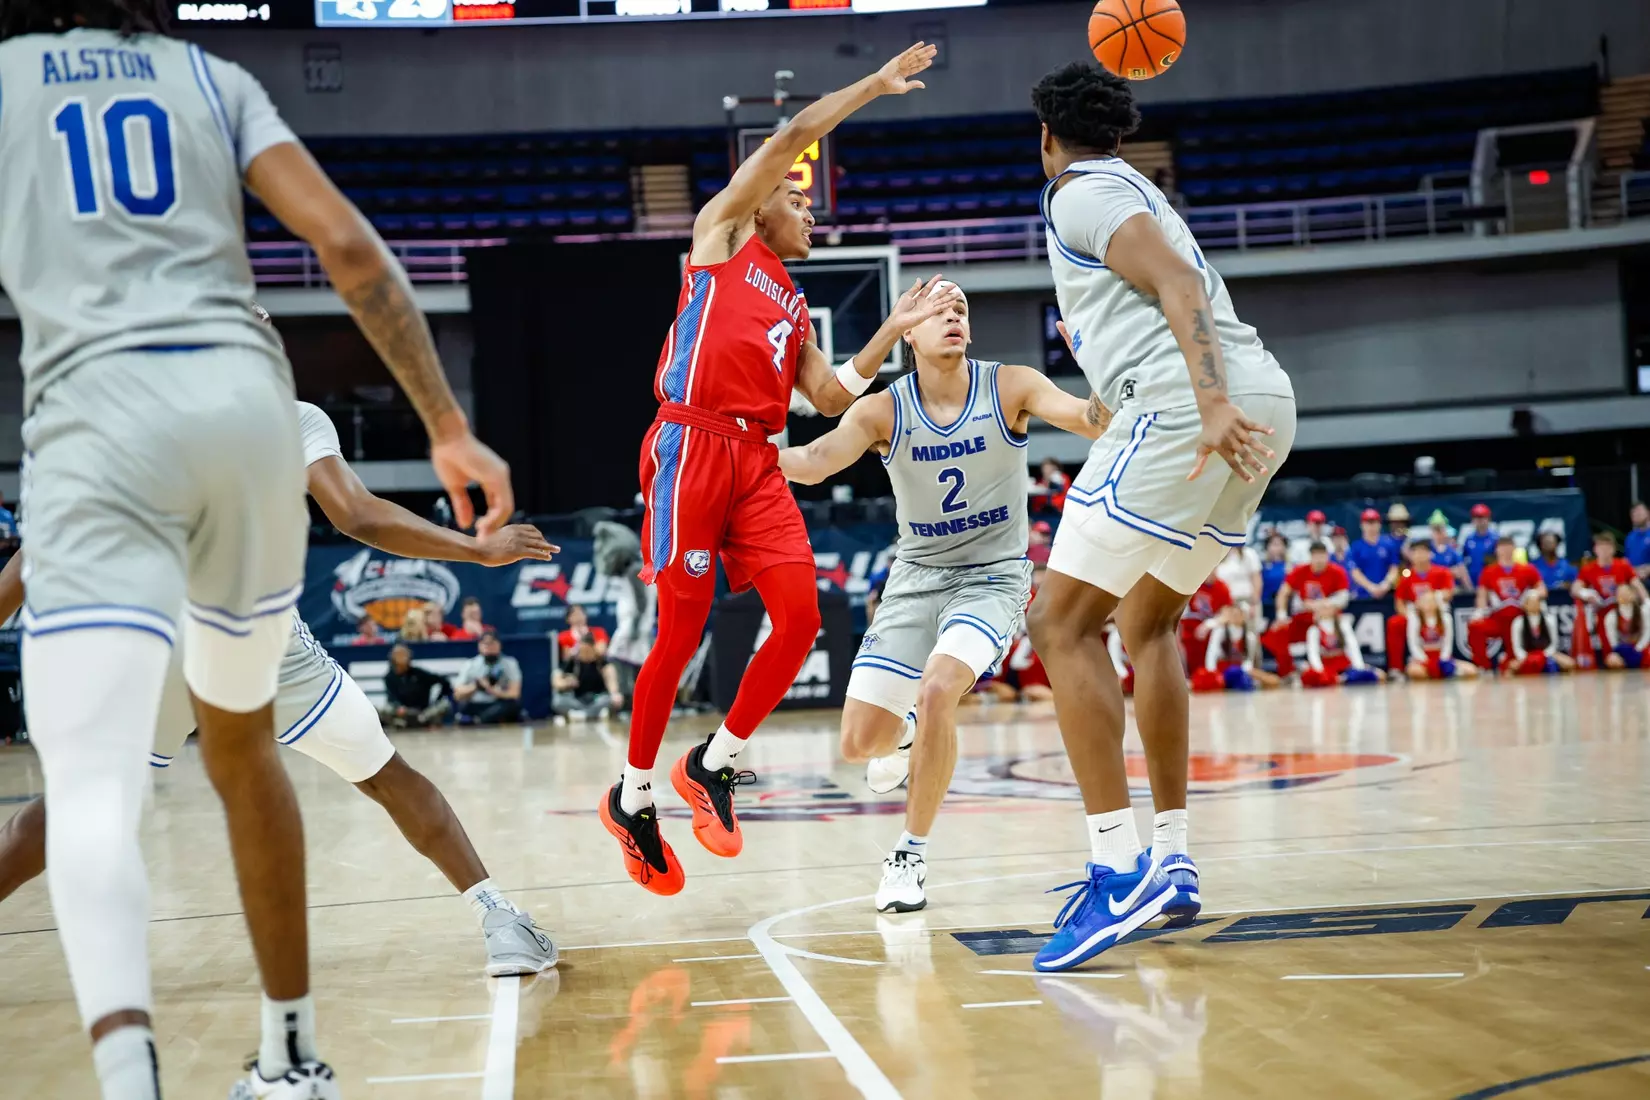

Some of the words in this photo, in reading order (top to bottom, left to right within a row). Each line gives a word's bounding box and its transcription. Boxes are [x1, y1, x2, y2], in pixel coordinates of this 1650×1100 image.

[43, 49, 157, 85] ALSTON
[50, 94, 179, 221] 10
[744, 261, 802, 324] LOUISIANA
[766, 318, 795, 373] 4
[911, 436, 987, 462] MIDDLE
[936, 465, 970, 516] 2
[908, 504, 1010, 538] TENNESSEE
